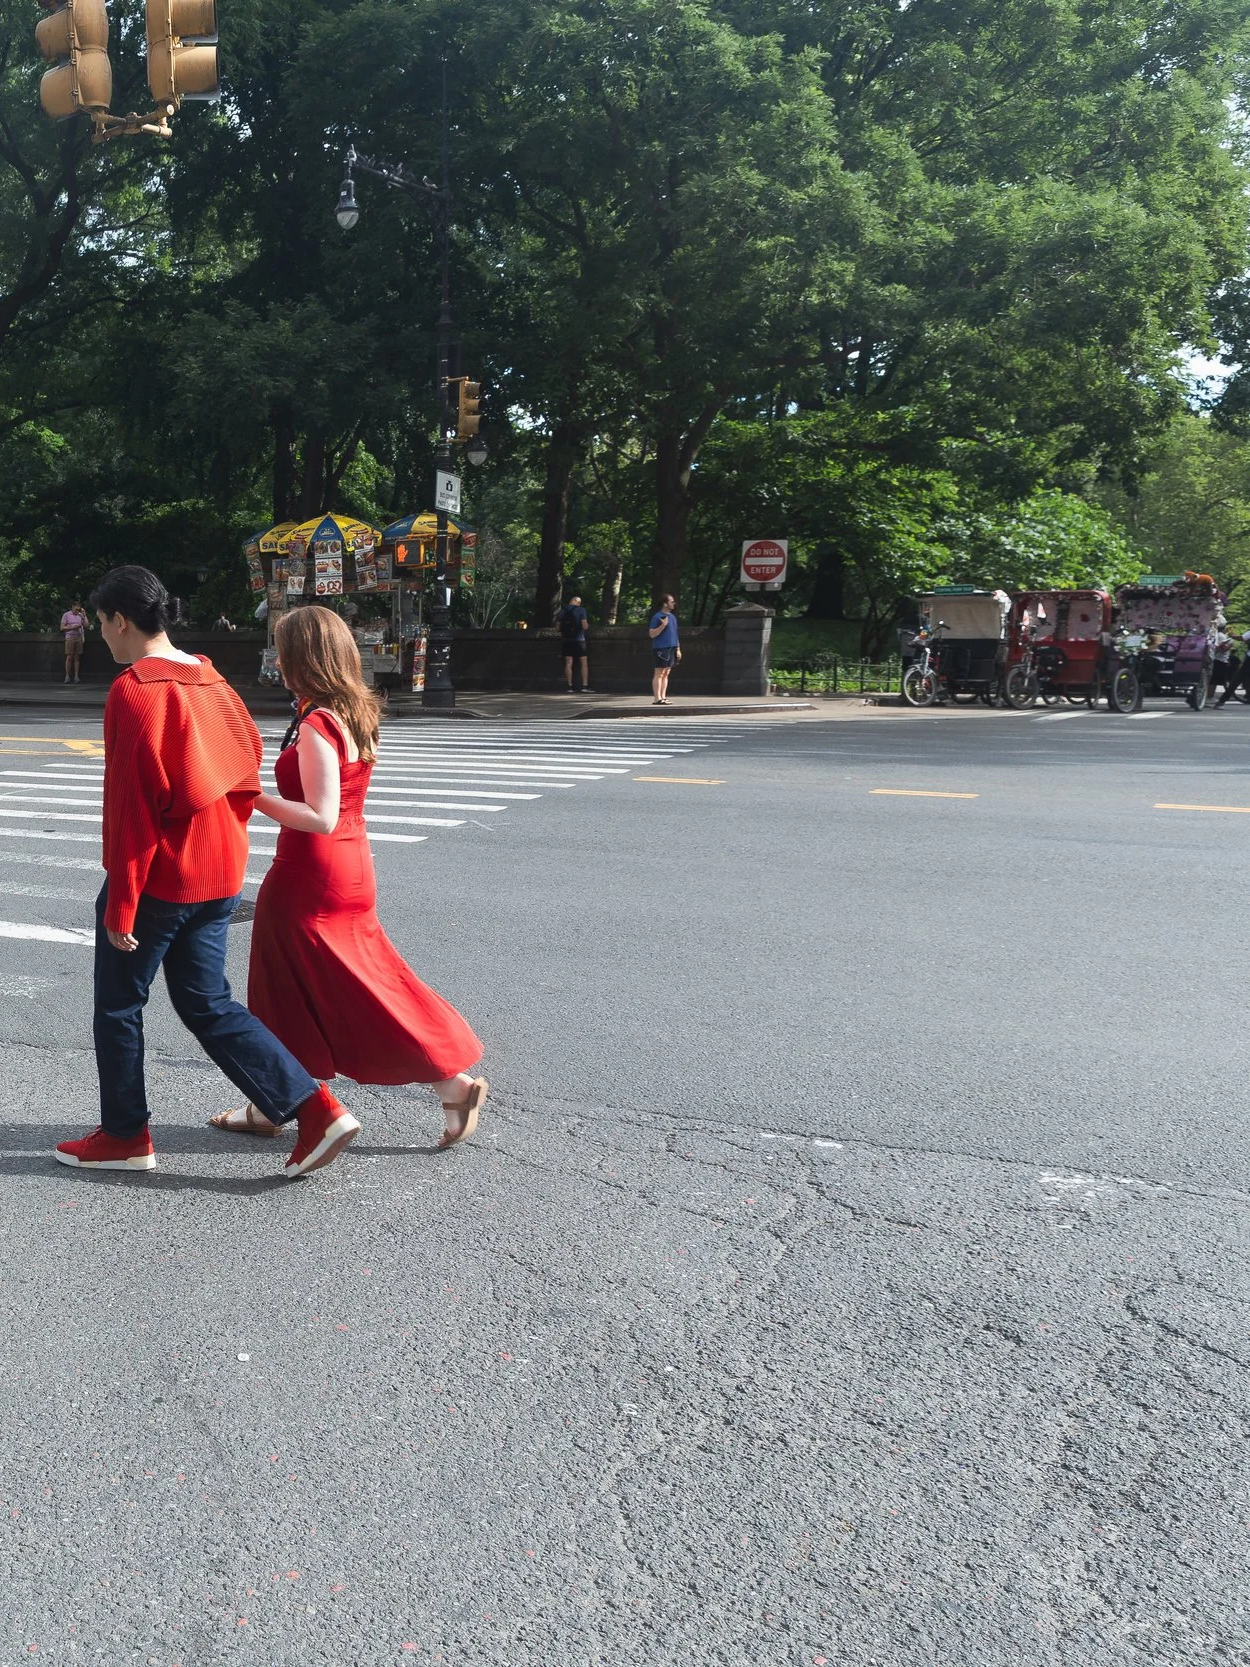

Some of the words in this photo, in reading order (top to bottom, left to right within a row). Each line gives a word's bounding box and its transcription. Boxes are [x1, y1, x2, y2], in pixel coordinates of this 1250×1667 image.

[750, 548, 761, 556] DO
[763, 548, 779, 556] NOT
[750, 566, 777, 574] ENTER
